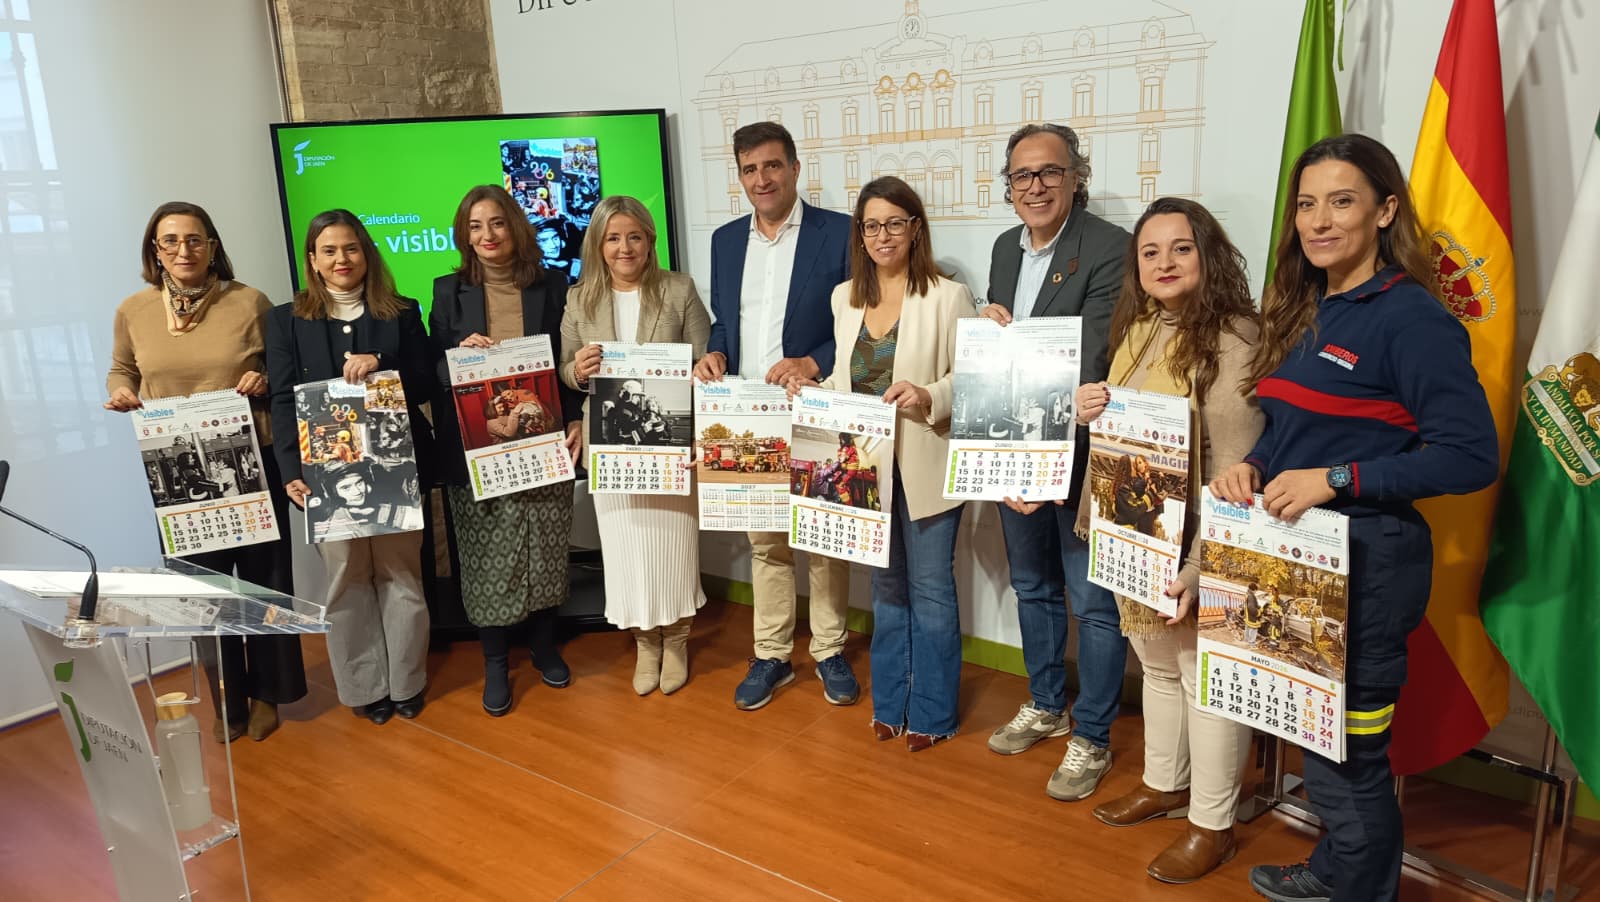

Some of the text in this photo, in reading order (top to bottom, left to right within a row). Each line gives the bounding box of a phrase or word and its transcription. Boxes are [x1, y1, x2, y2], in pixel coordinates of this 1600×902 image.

[359, 213, 420, 225] Calendario
[386, 227, 457, 253] visibl
[704, 386, 731, 394] visibles
[1532, 403, 1544, 416] LA
[1579, 431, 1596, 450] POR
[1212, 504, 1251, 520] visibles
[1251, 656, 1270, 666] MAYO
[1211, 678, 1333, 727] 11 12 13 14 15 16 17
[1233, 673, 1239, 681] 5
[1270, 685, 1275, 693] 7
[1288, 692, 1293, 700] 8
[1306, 699, 1312, 707] 9
[1321, 705, 1333, 716] 10
[1306, 688, 1312, 696] 2
[1324, 695, 1330, 703] 3
[1211, 689, 1333, 739] 18 19 20 21 22 23 24
[1210, 699, 1331, 750] 25 26 27 28 29 30 31
